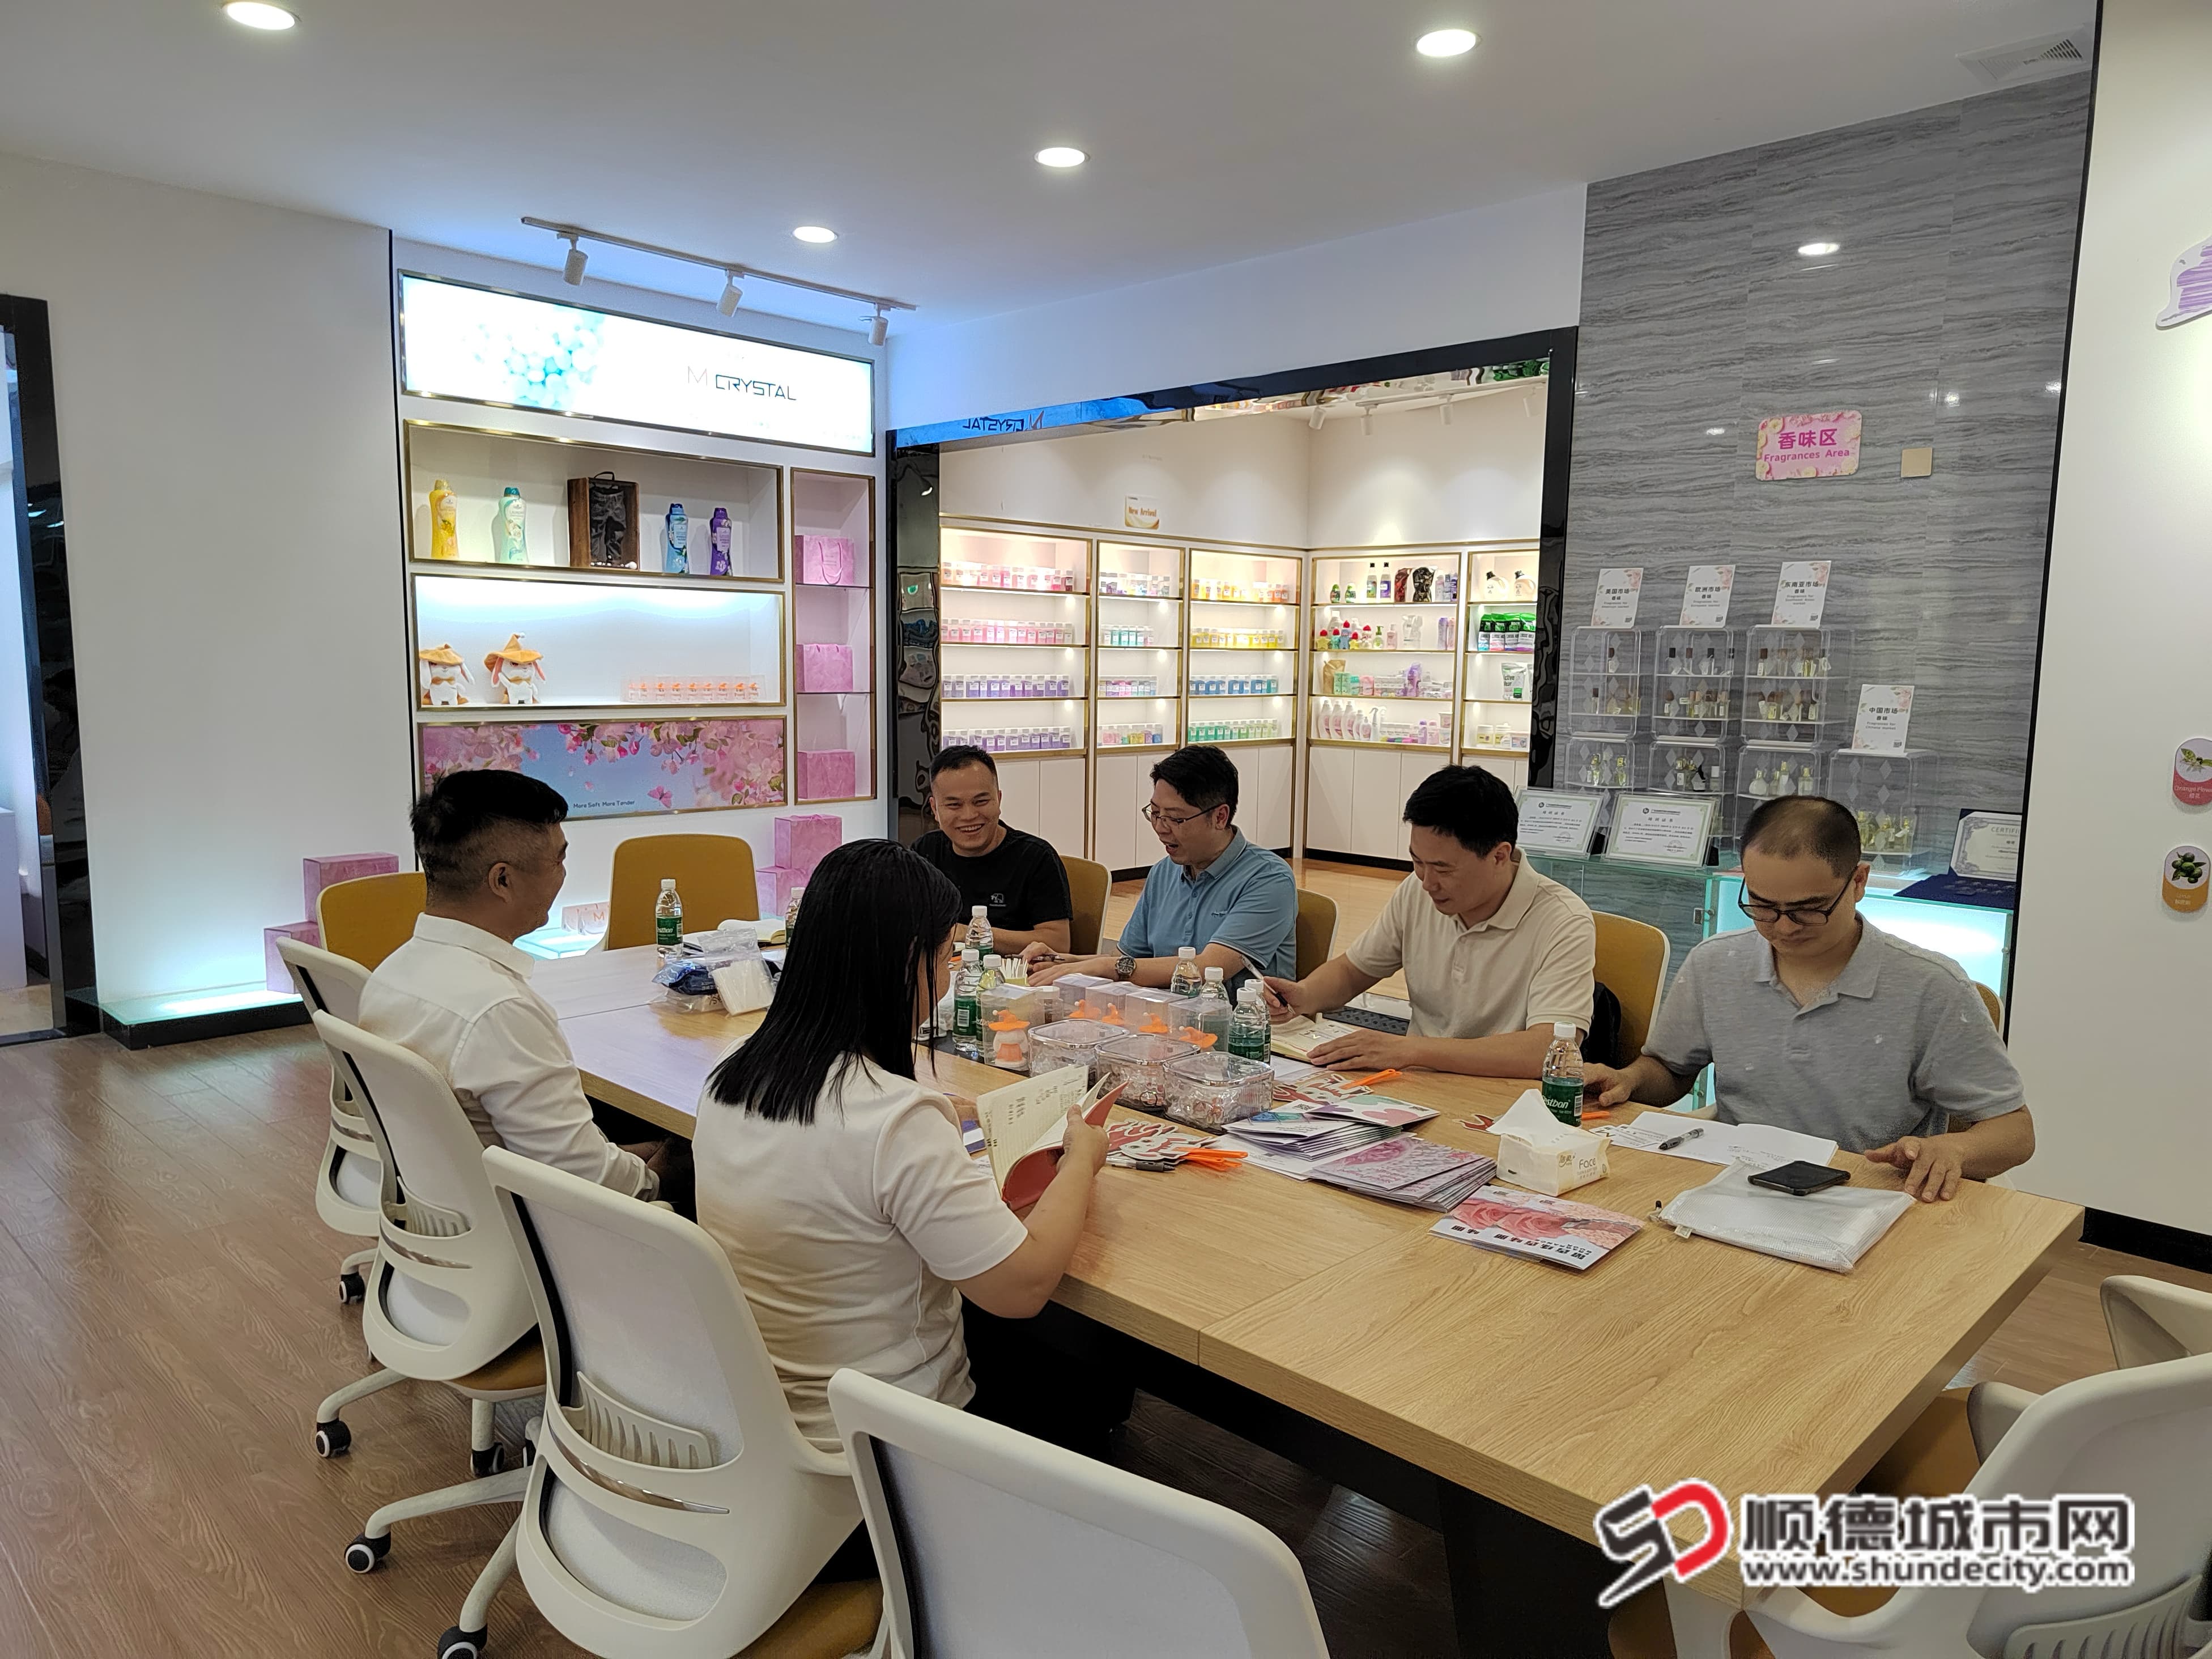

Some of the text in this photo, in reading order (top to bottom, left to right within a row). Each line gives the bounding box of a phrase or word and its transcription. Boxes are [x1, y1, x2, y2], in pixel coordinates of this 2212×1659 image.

[687, 365, 797, 401] M CRYSTAL
[1777, 428, 1837, 450] 香味区
[1764, 449, 1850, 463] Fragrances Area
